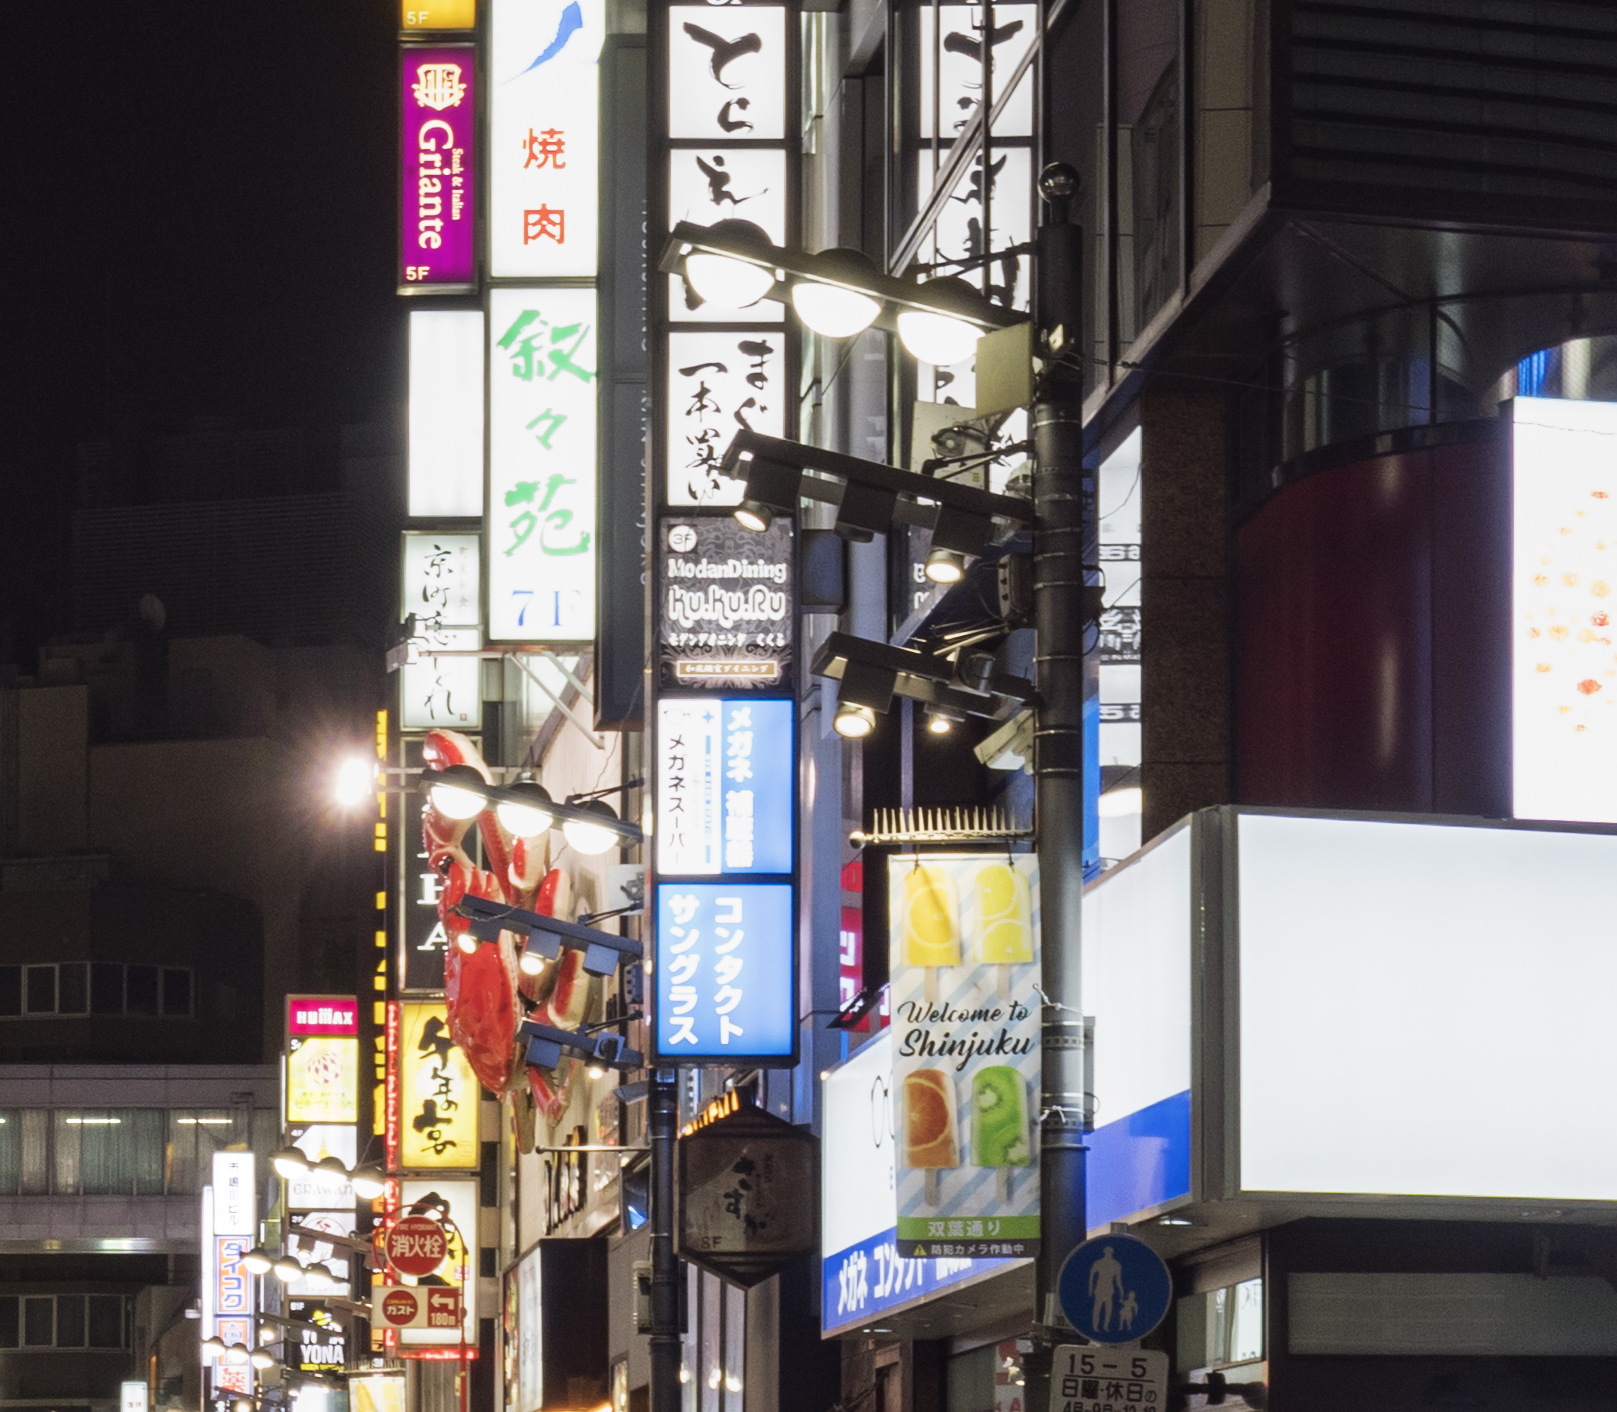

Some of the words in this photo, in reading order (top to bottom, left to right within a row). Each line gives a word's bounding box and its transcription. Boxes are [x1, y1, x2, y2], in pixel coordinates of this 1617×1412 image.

[406, 11, 429, 26] 5F
[418, 119, 453, 250] Griante
[522, 127, 566, 245] 焼肉
[405, 267, 430, 281] 5F
[667, 558, 787, 585] ModanDining
[726, 706, 753, 781] メガネ
[667, 733, 687, 866] メガネスーパー
[667, 894, 700, 1045] サングラス
[714, 897, 745, 1045] コンタクト
[296, 1007, 354, 1026] HUMAX
[897, 999, 1003, 1025] Welcome
[1006, 1000, 1031, 1024] to
[897, 1027, 1036, 1072] Shinjuku
[928, 1219, 1002, 1238] 双葉通り
[391, 1237, 443, 1259] 消火栓
[930, 1243, 1024, 1256] 防犯カメラ作動中
[838, 1246, 869, 1316] メガネ
[386, 1305, 415, 1316] ガスト
[430, 1312, 456, 1326] 180m
[300, 1344, 345, 1364] YONA
